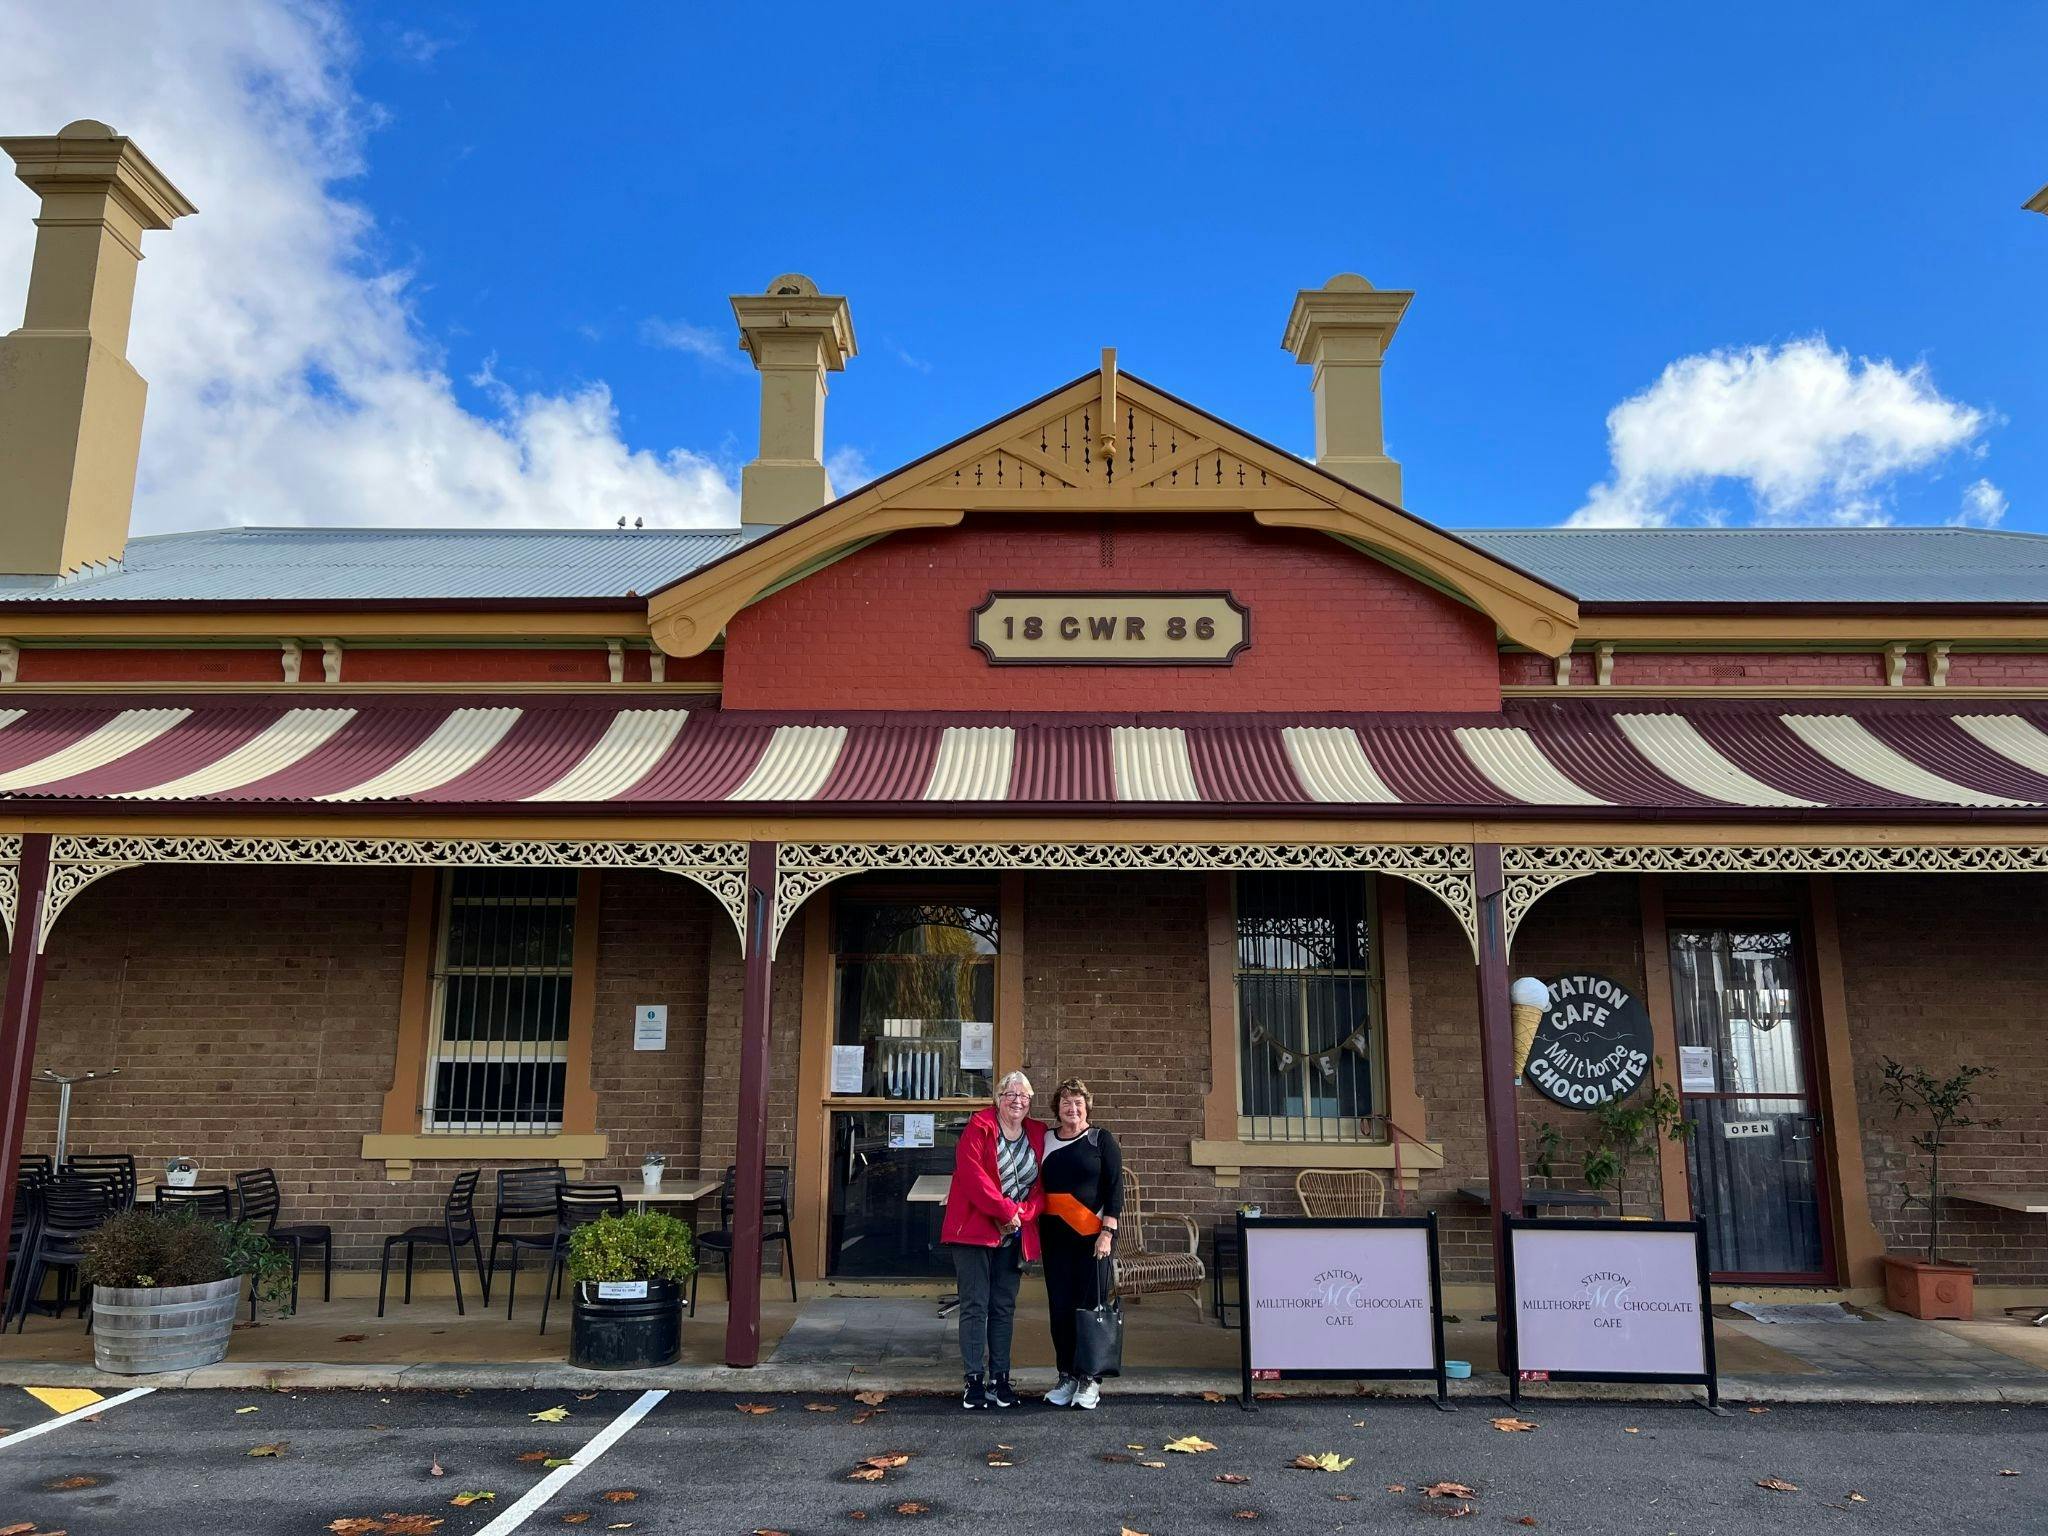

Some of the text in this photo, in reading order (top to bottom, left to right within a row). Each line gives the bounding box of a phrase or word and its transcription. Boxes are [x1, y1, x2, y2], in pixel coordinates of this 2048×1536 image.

[1002, 616, 1215, 640] 18 GWR 86
[1551, 1002, 1610, 1030] CAFE
[1544, 1041, 1628, 1079] Millthorpe
[1530, 1049, 1648, 1105] CHOCOLATES
[1731, 1124, 1769, 1135] OPEN
[1313, 1269, 1363, 1285] STATION
[1581, 1271, 1631, 1287] STATION
[1256, 1298, 1423, 1309] MILLTHORPE CHOCOLATE
[1522, 1300, 1693, 1313] MILLTHORPE CHOCOLATE
[1326, 1315, 1353, 1326] CAFE
[1594, 1318, 1622, 1328] CAFE
